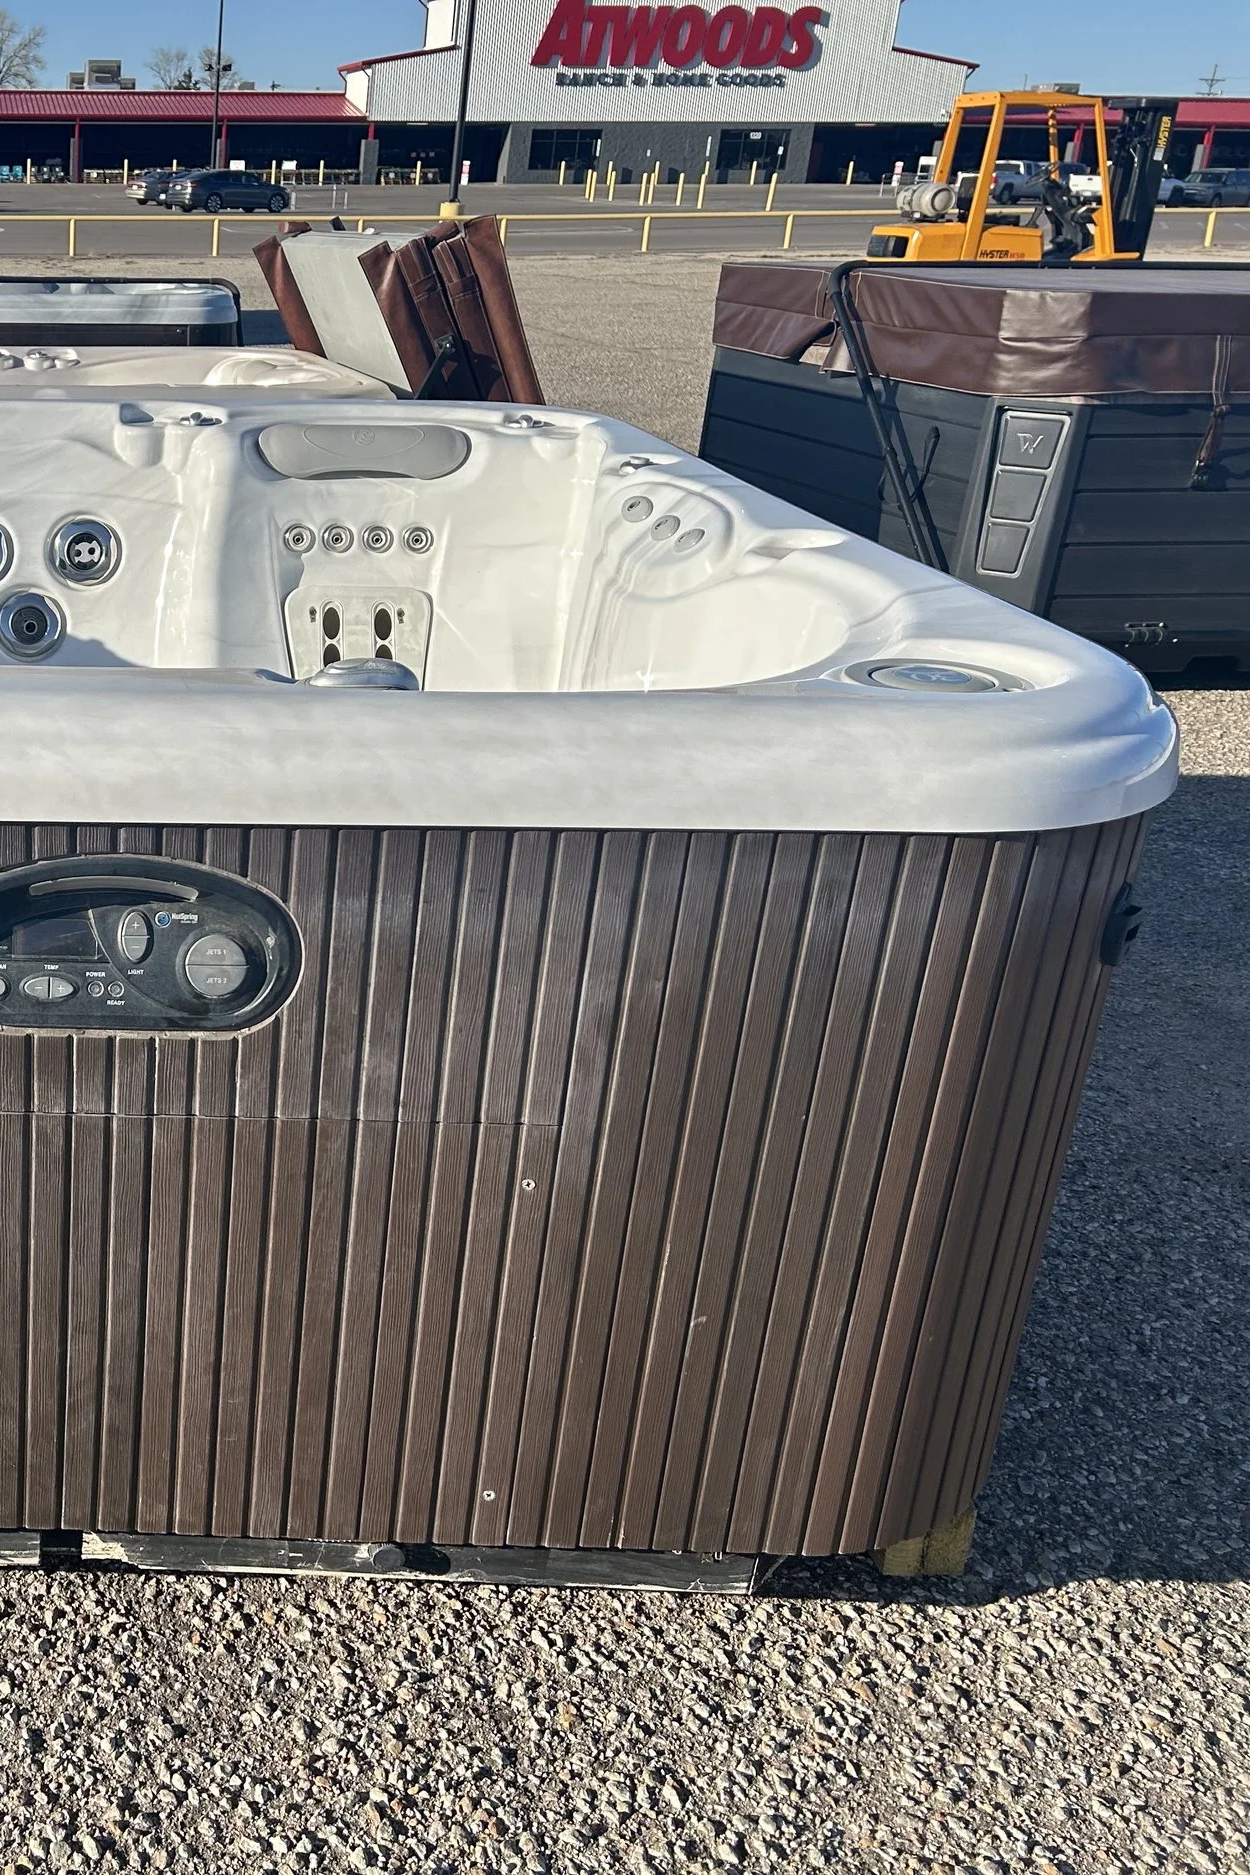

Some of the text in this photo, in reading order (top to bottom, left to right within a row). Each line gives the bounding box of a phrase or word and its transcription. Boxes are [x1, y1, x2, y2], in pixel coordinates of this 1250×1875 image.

[530, 0, 829, 71] ATWOODS
[555, 72, 787, 88] RANCH & HOME GOODS
[1156, 115, 1172, 149] HYSTER
[979, 249, 1010, 259] HYSTER
